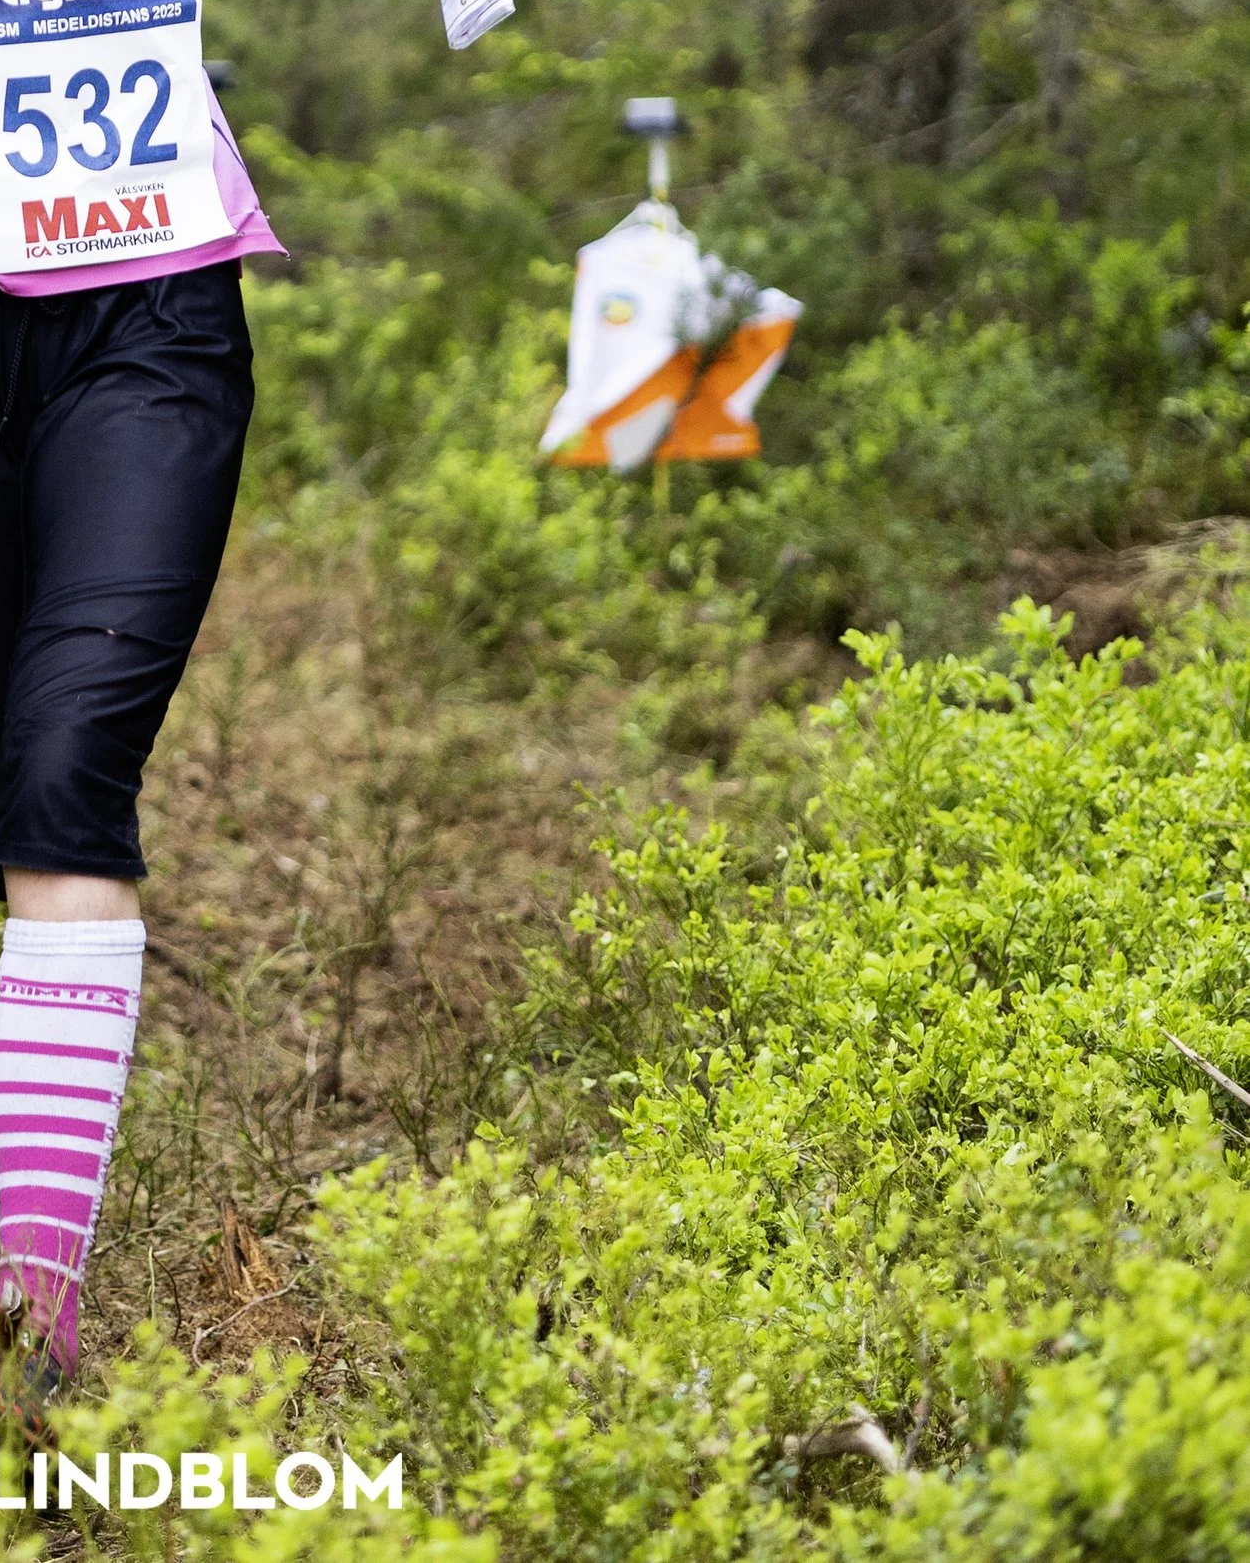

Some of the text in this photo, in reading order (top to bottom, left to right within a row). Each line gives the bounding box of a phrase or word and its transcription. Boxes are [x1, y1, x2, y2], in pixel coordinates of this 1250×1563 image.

[33, 7, 150, 35] MEDELDISTANS
[152, 2, 183, 20] 2025
[2, 59, 178, 178] 532
[114, 182, 165, 196] VÄLSVIKEN
[21, 193, 172, 244] MAXI
[26, 229, 175, 259] ICA STORMARKNAD
